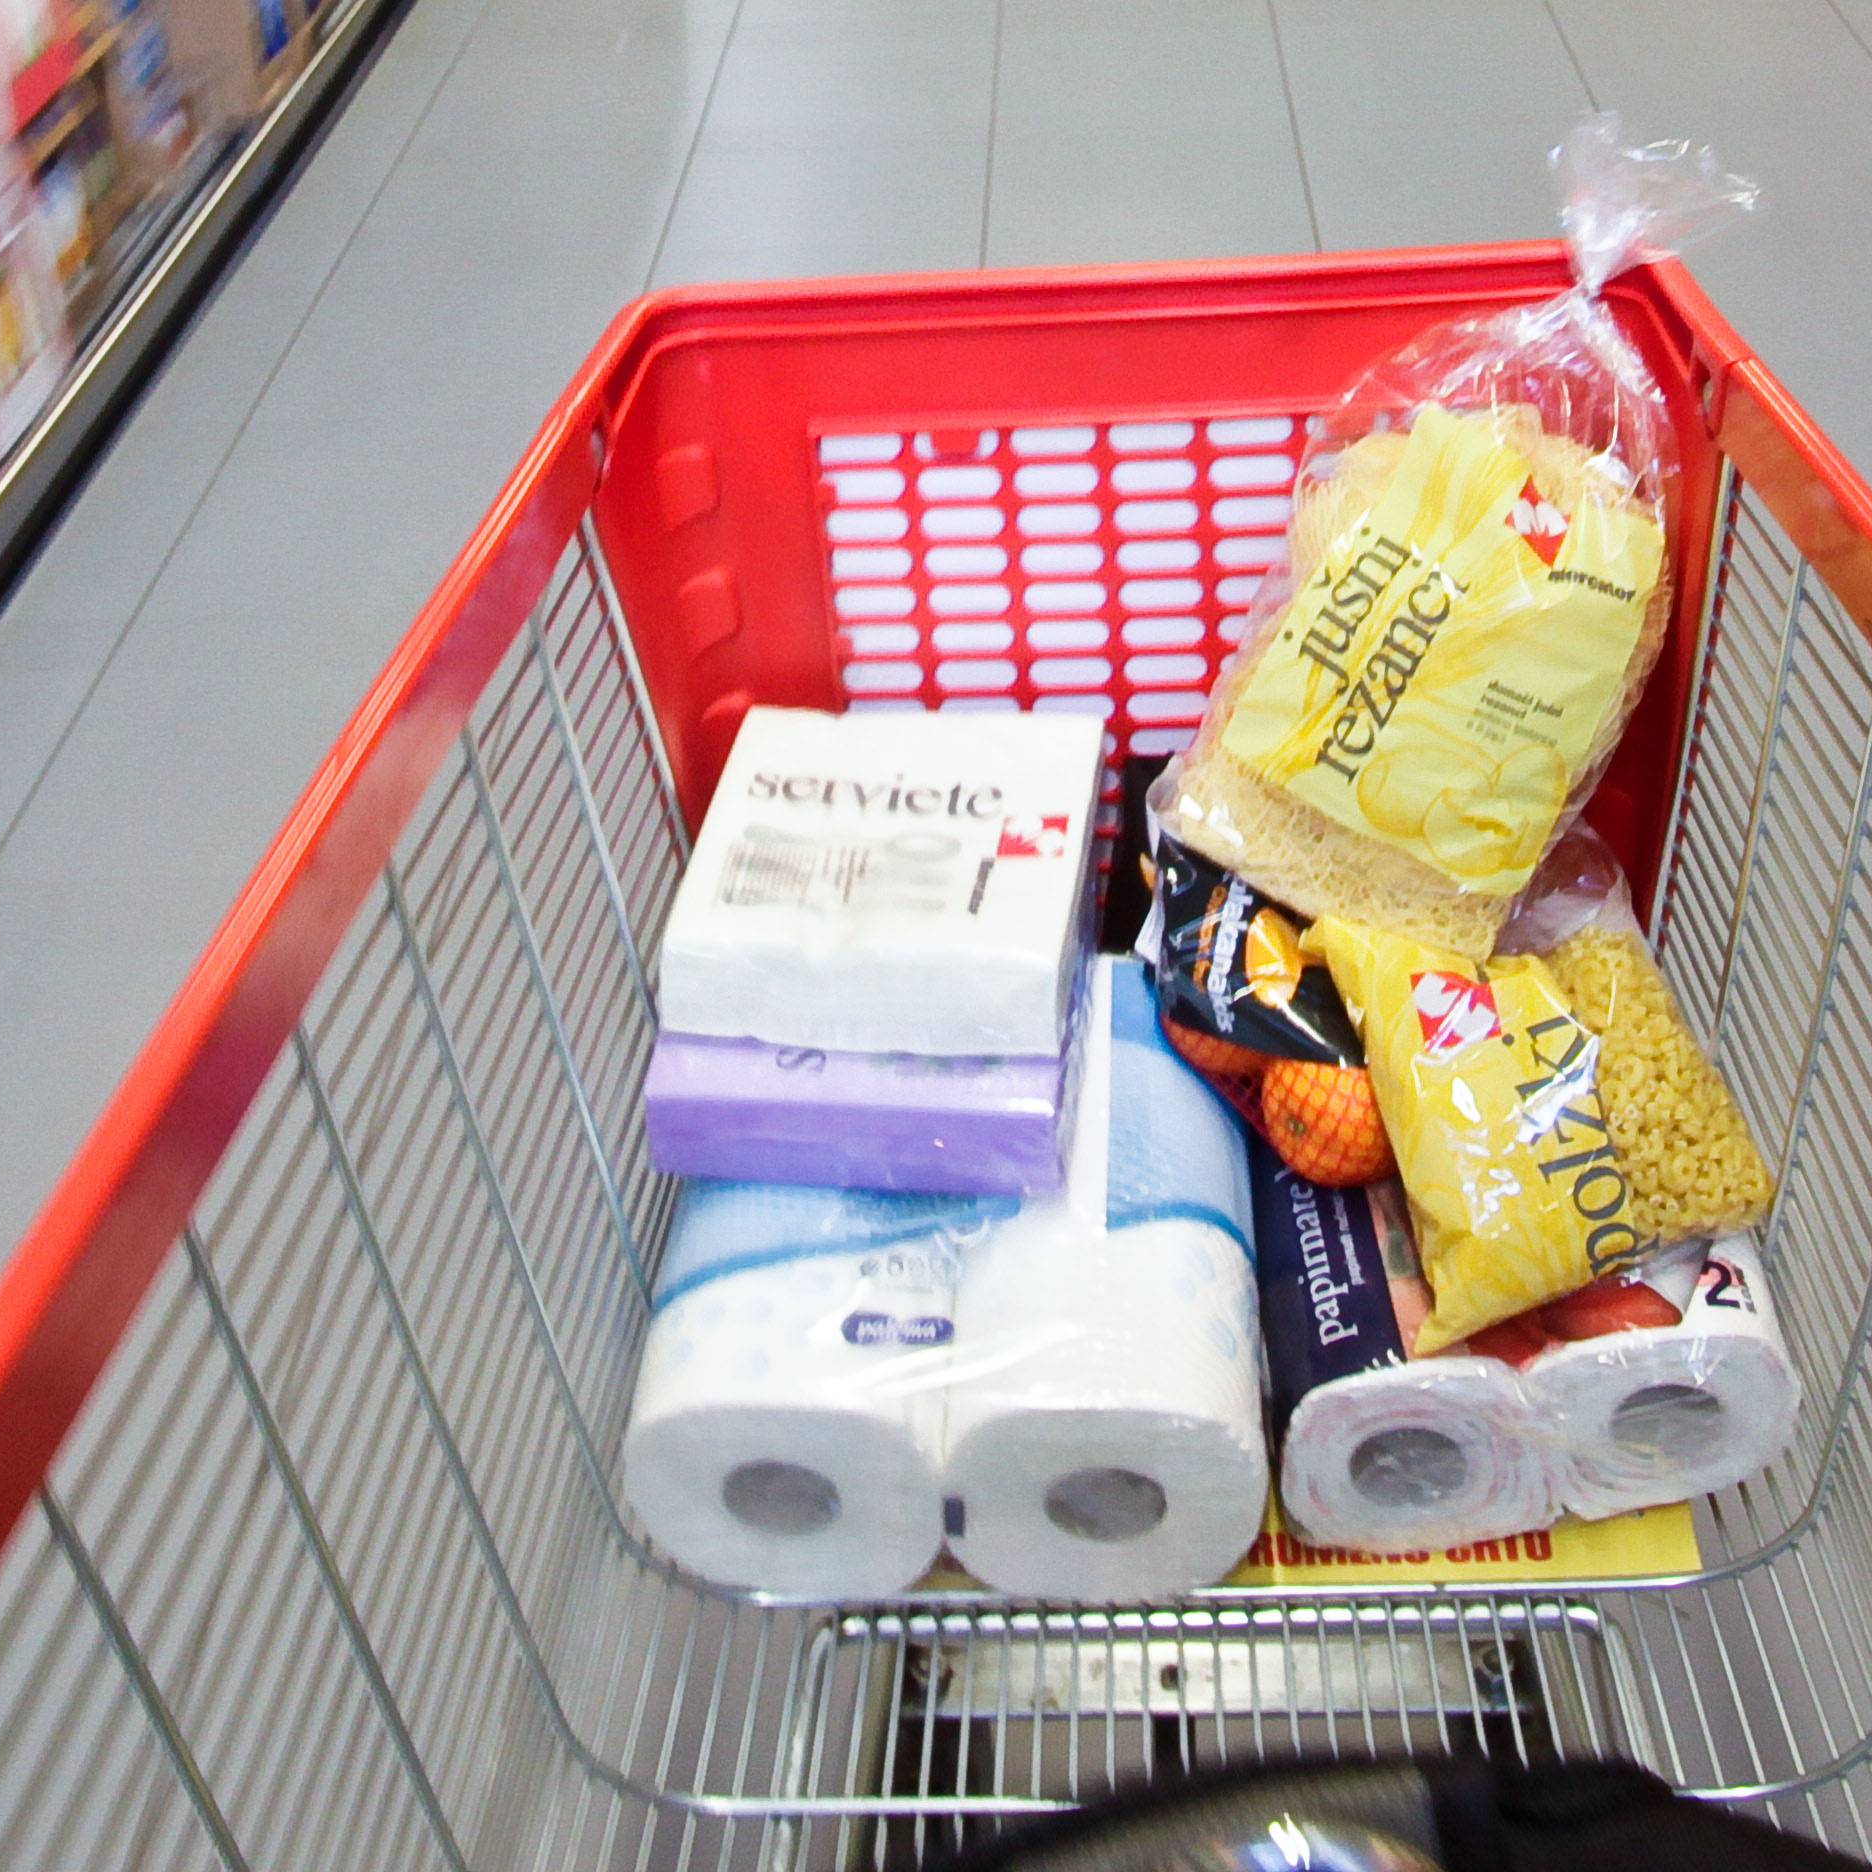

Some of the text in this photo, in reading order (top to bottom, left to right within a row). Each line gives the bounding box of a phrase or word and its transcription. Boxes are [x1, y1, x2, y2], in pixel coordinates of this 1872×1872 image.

[1285, 527, 1412, 696] jušni
[1315, 559, 1470, 785] rezanci
[1289, 1182, 1359, 1346] papirnate
[1700, 1260, 1741, 1309] 2
